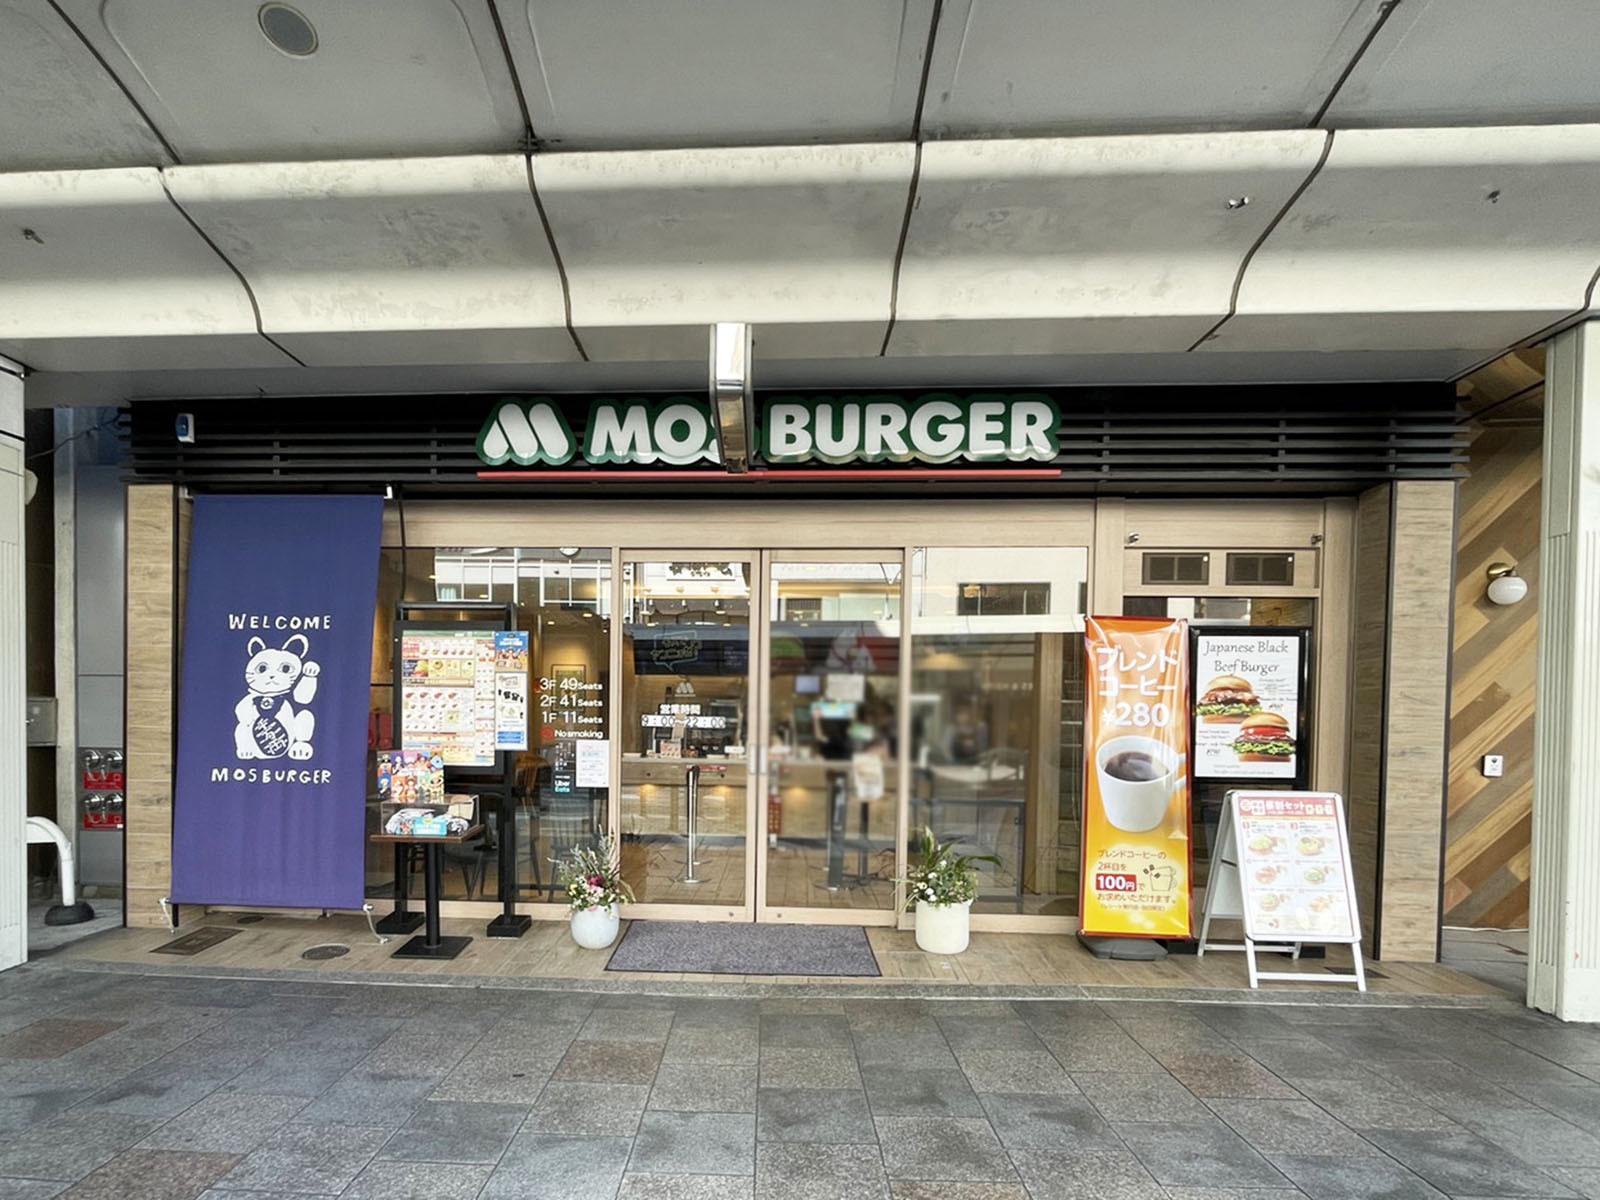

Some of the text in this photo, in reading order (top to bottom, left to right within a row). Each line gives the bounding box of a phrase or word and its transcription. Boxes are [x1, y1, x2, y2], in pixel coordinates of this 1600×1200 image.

[770, 401, 1055, 457] BURGER
[228, 613, 332, 630] WELCOME
[1203, 640, 1289, 656] Japanese Black
[1096, 644, 1179, 673] ブレンド
[1214, 659, 1280, 676] Beef Burger
[539, 677, 556, 690] 3F
[1098, 675, 1177, 697] コーヒー
[540, 694, 557, 707] 2F
[541, 711, 557, 724] 1F
[1101, 701, 1169, 727] ¥280
[1097, 849, 1167, 860] ブレンドコーヒーの
